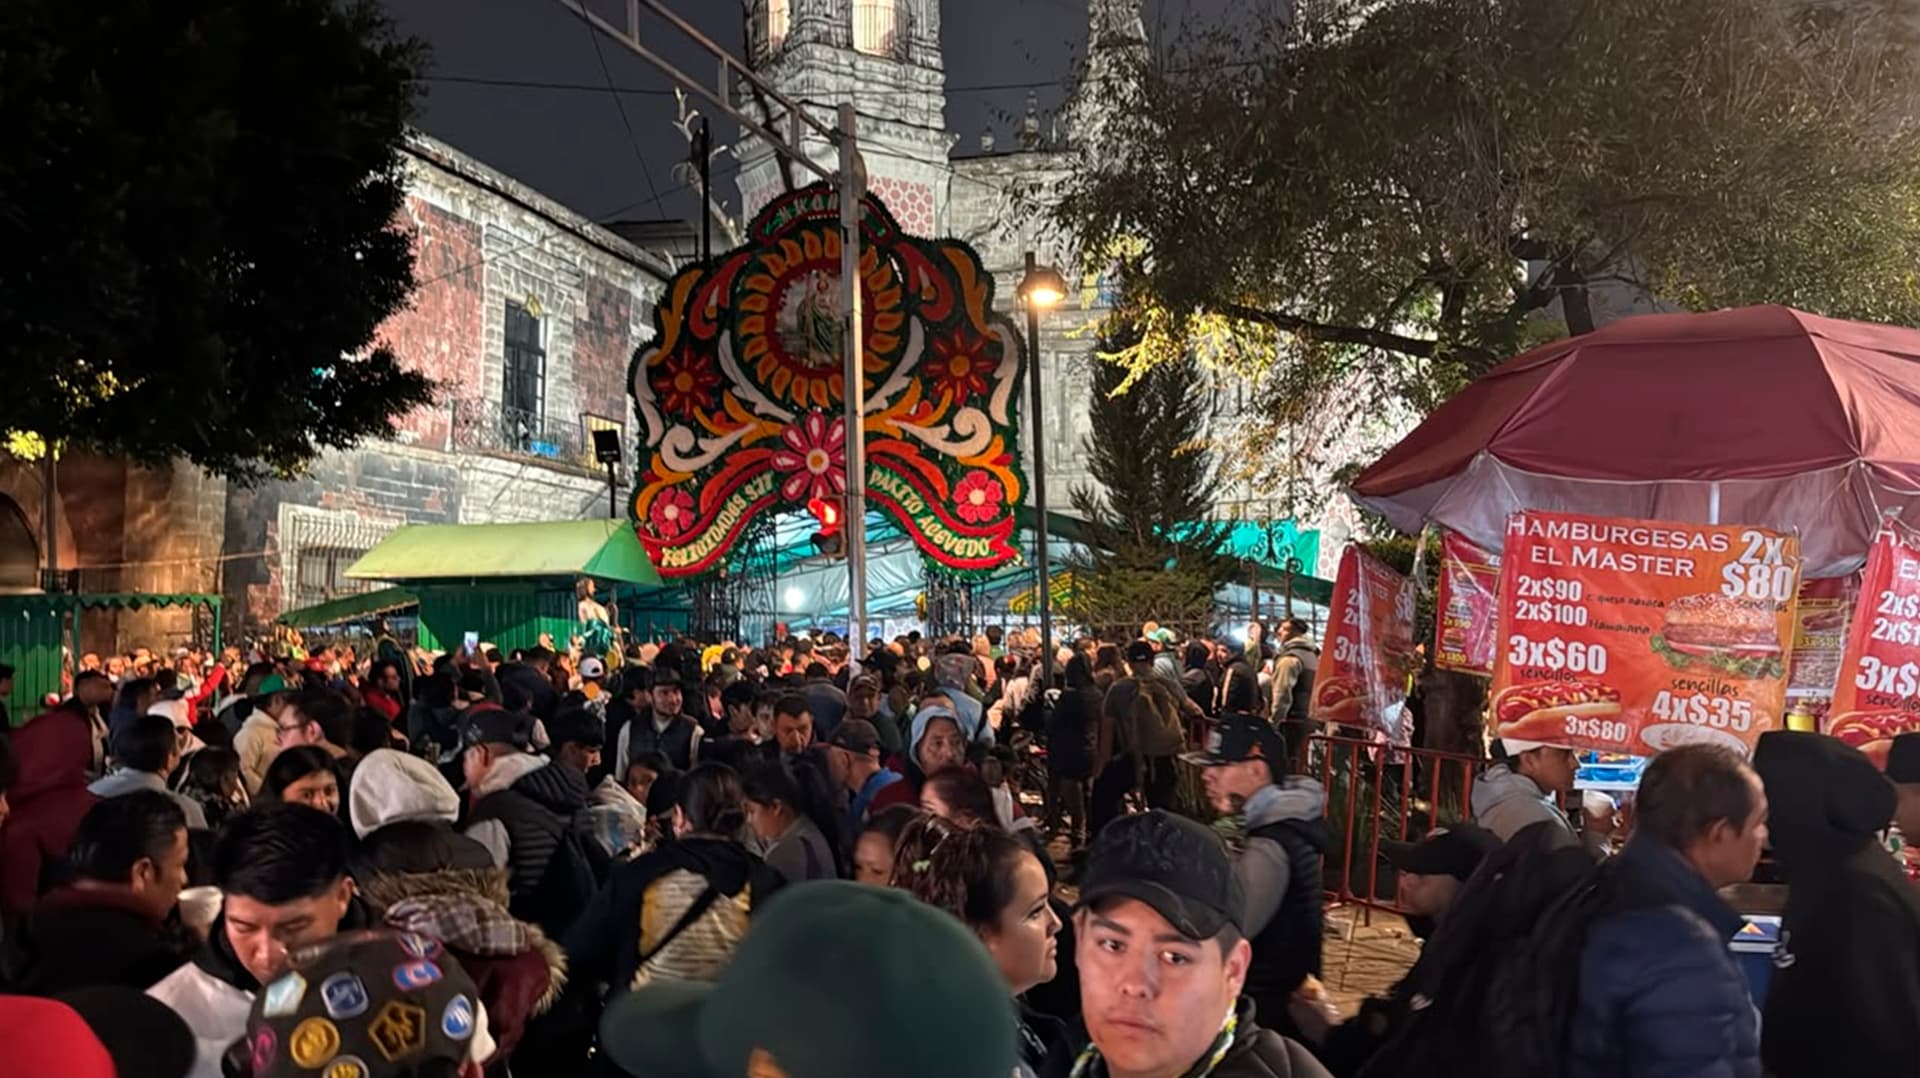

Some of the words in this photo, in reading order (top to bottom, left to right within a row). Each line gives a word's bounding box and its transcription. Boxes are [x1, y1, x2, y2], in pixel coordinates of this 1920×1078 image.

[916, 514, 991, 558] ACEVEDO
[1506, 513, 1730, 553] HAMBURGESAS
[1739, 530, 1785, 566] 2x
[1531, 545, 1564, 567] EL
[1571, 545, 1695, 578] MASTER
[1516, 575, 1583, 603] 2x$90
[1720, 560, 1794, 602] $80
[1515, 599, 1588, 627] 2x$100
[1877, 590, 1920, 619] 2x$
[1507, 634, 1608, 675] 3x$60
[1671, 675, 1740, 698] sencillas
[1855, 655, 1920, 700] 3x$
[1564, 714, 1628, 743] 3x$80
[1651, 689, 1752, 733] 4x$35
